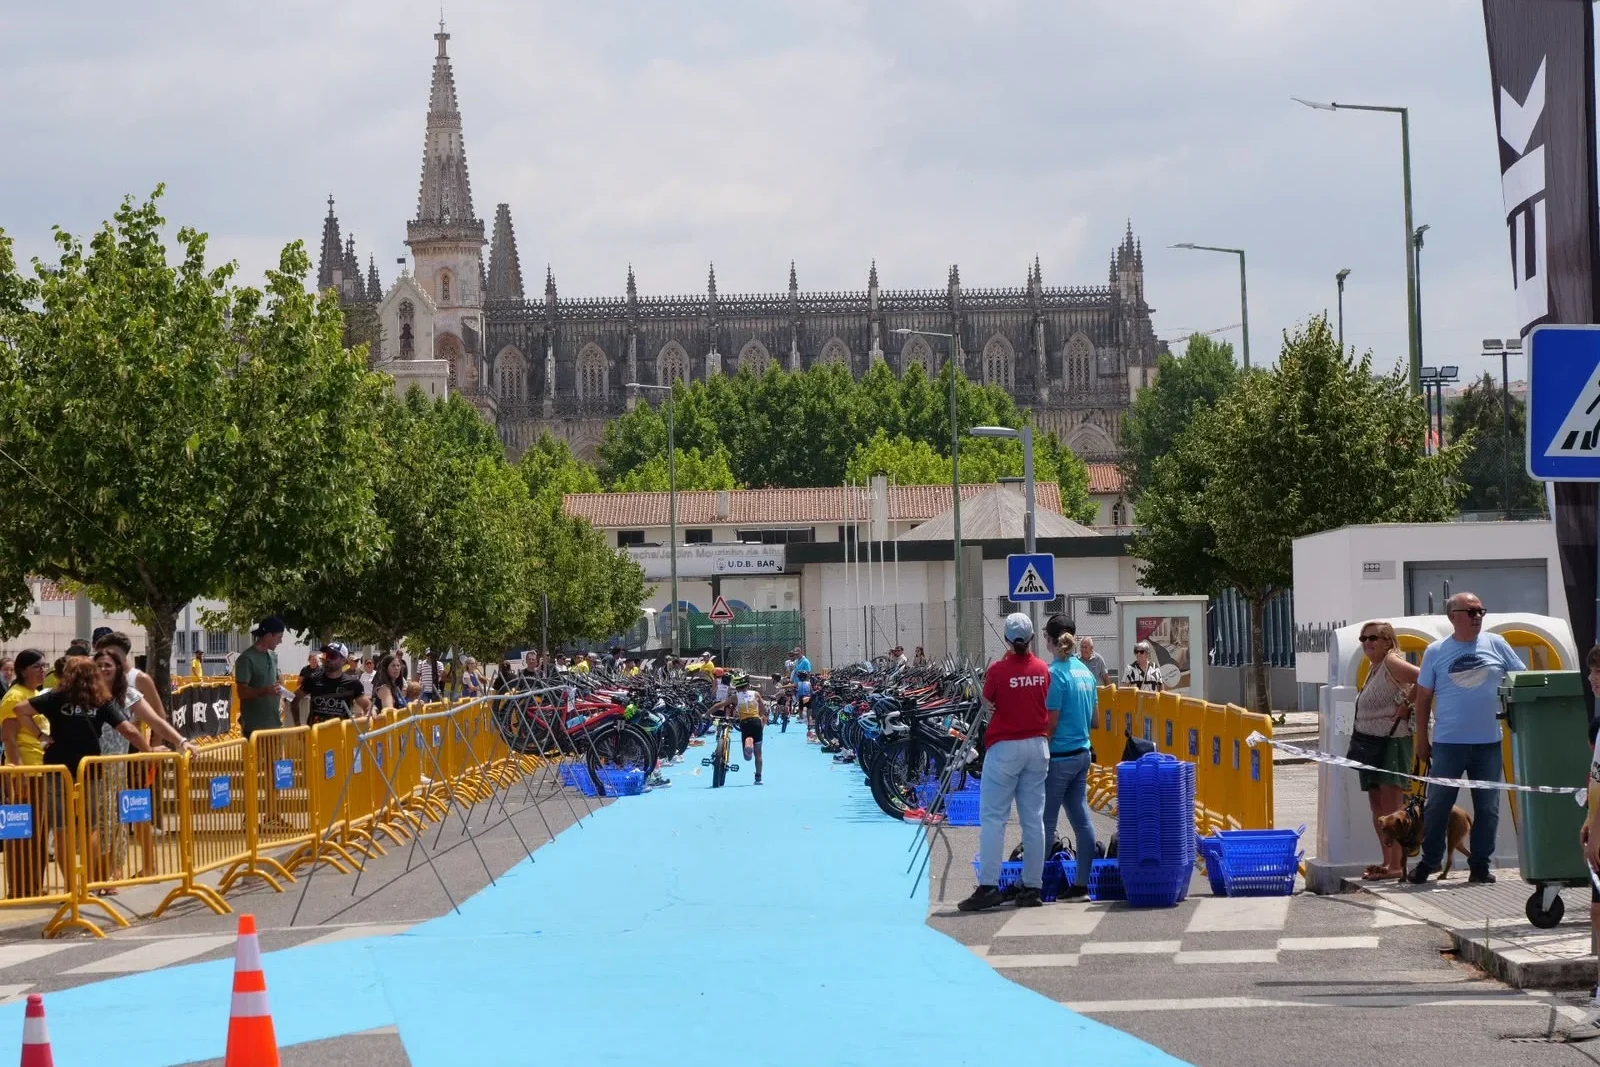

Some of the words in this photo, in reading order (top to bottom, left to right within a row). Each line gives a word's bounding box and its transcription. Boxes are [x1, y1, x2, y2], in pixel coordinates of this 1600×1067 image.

[728, 560, 754, 568] U.D.B.
[757, 560, 775, 568] BAR
[1009, 675, 1045, 688] STAFF
